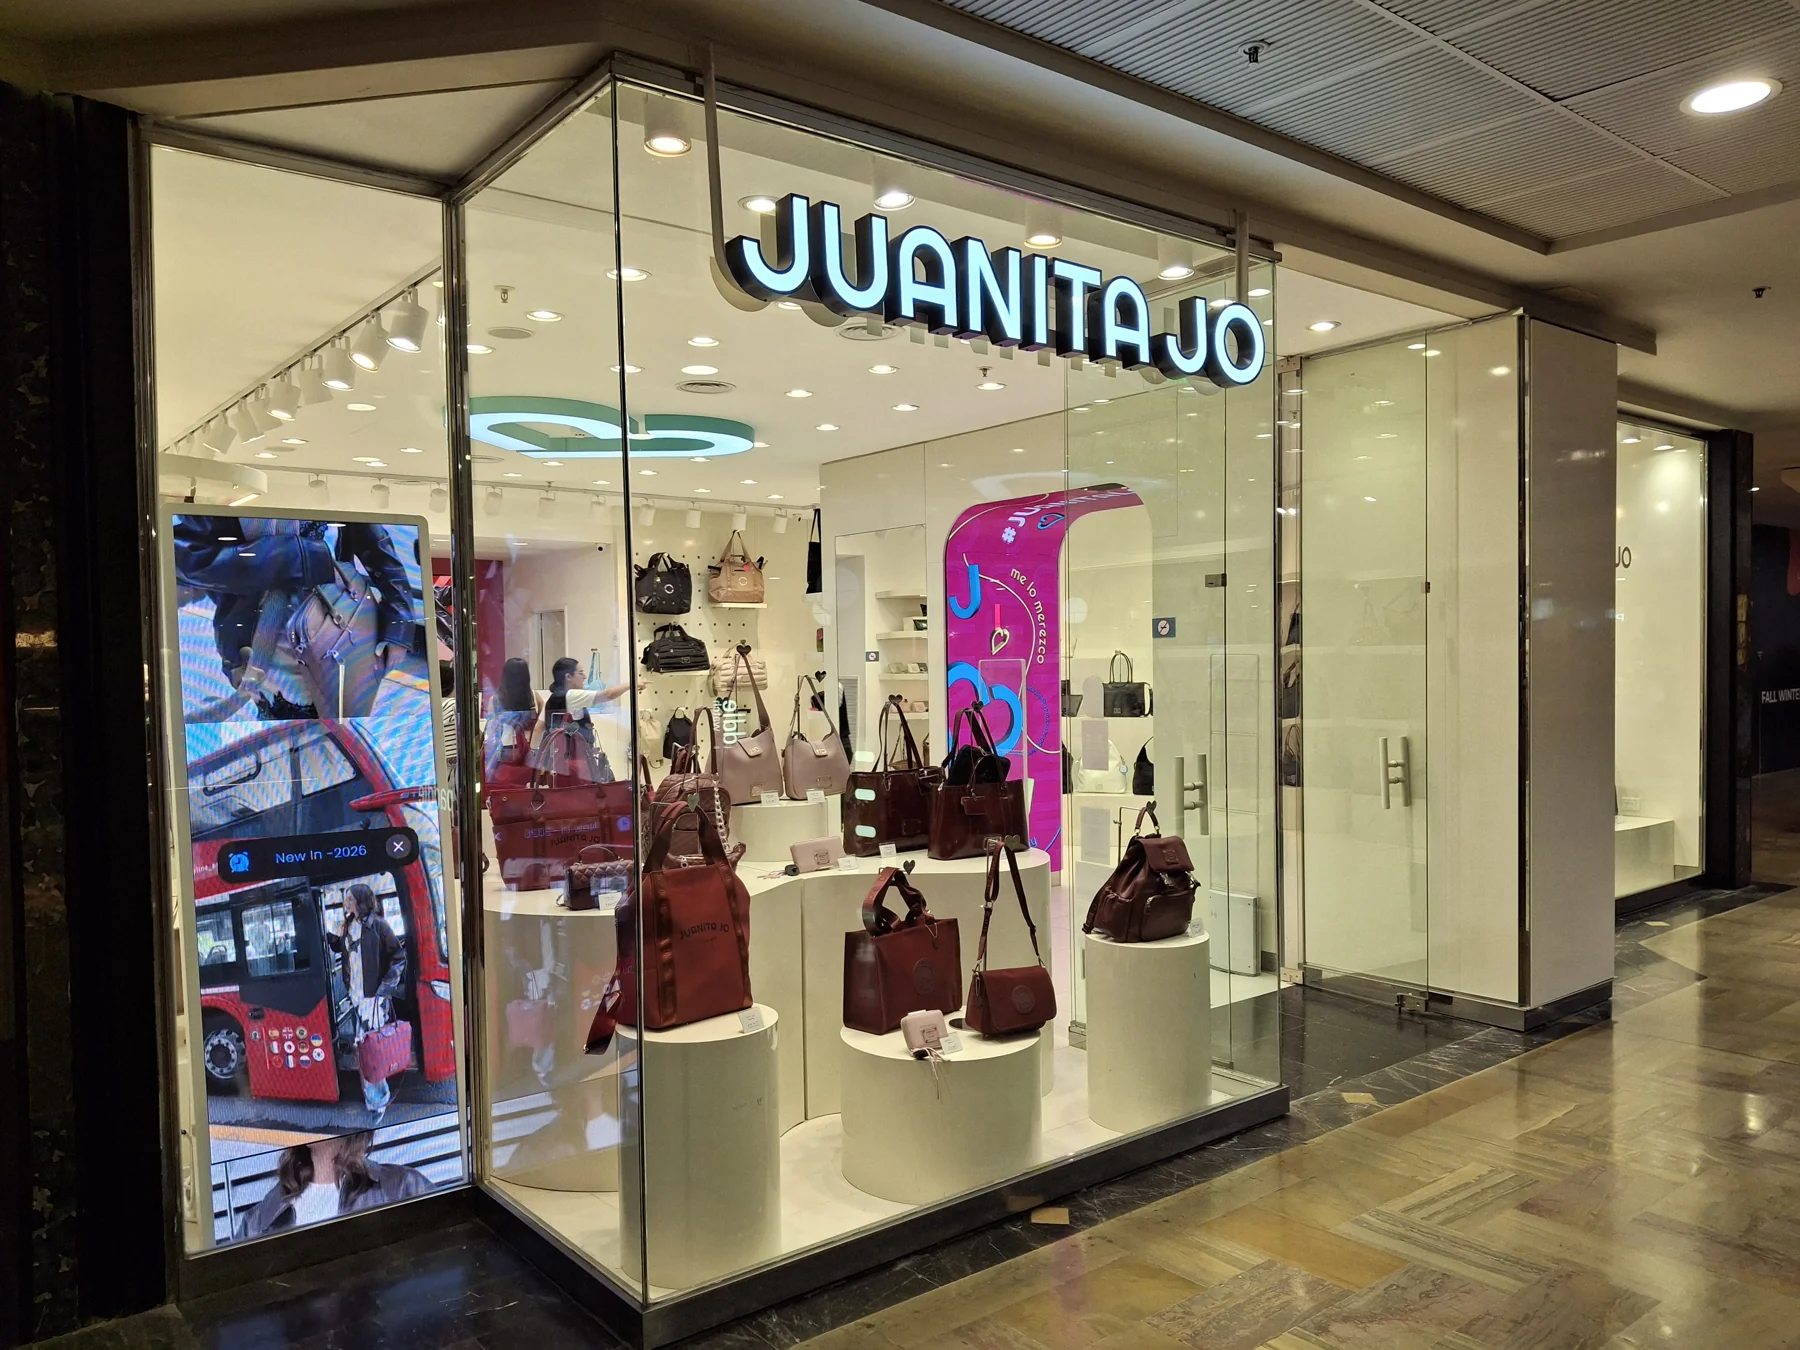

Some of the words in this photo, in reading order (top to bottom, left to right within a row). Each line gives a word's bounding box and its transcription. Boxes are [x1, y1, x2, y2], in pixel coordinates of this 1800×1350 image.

[738, 193, 1152, 365] JUANITA
[1164, 296, 1266, 386] JO
[1010, 568, 1027, 585] me
[1026, 581, 1037, 598] lo
[1033, 600, 1047, 664] merezco
[1761, 690, 1778, 704] FALL
[550, 834, 587, 848] JUANITA
[589, 835, 600, 844] JO
[275, 852, 307, 864] New
[310, 849, 323, 860] In
[326, 844, 367, 859] -2026
[680, 922, 717, 940] JUANITA
[719, 922, 730, 933] JO
